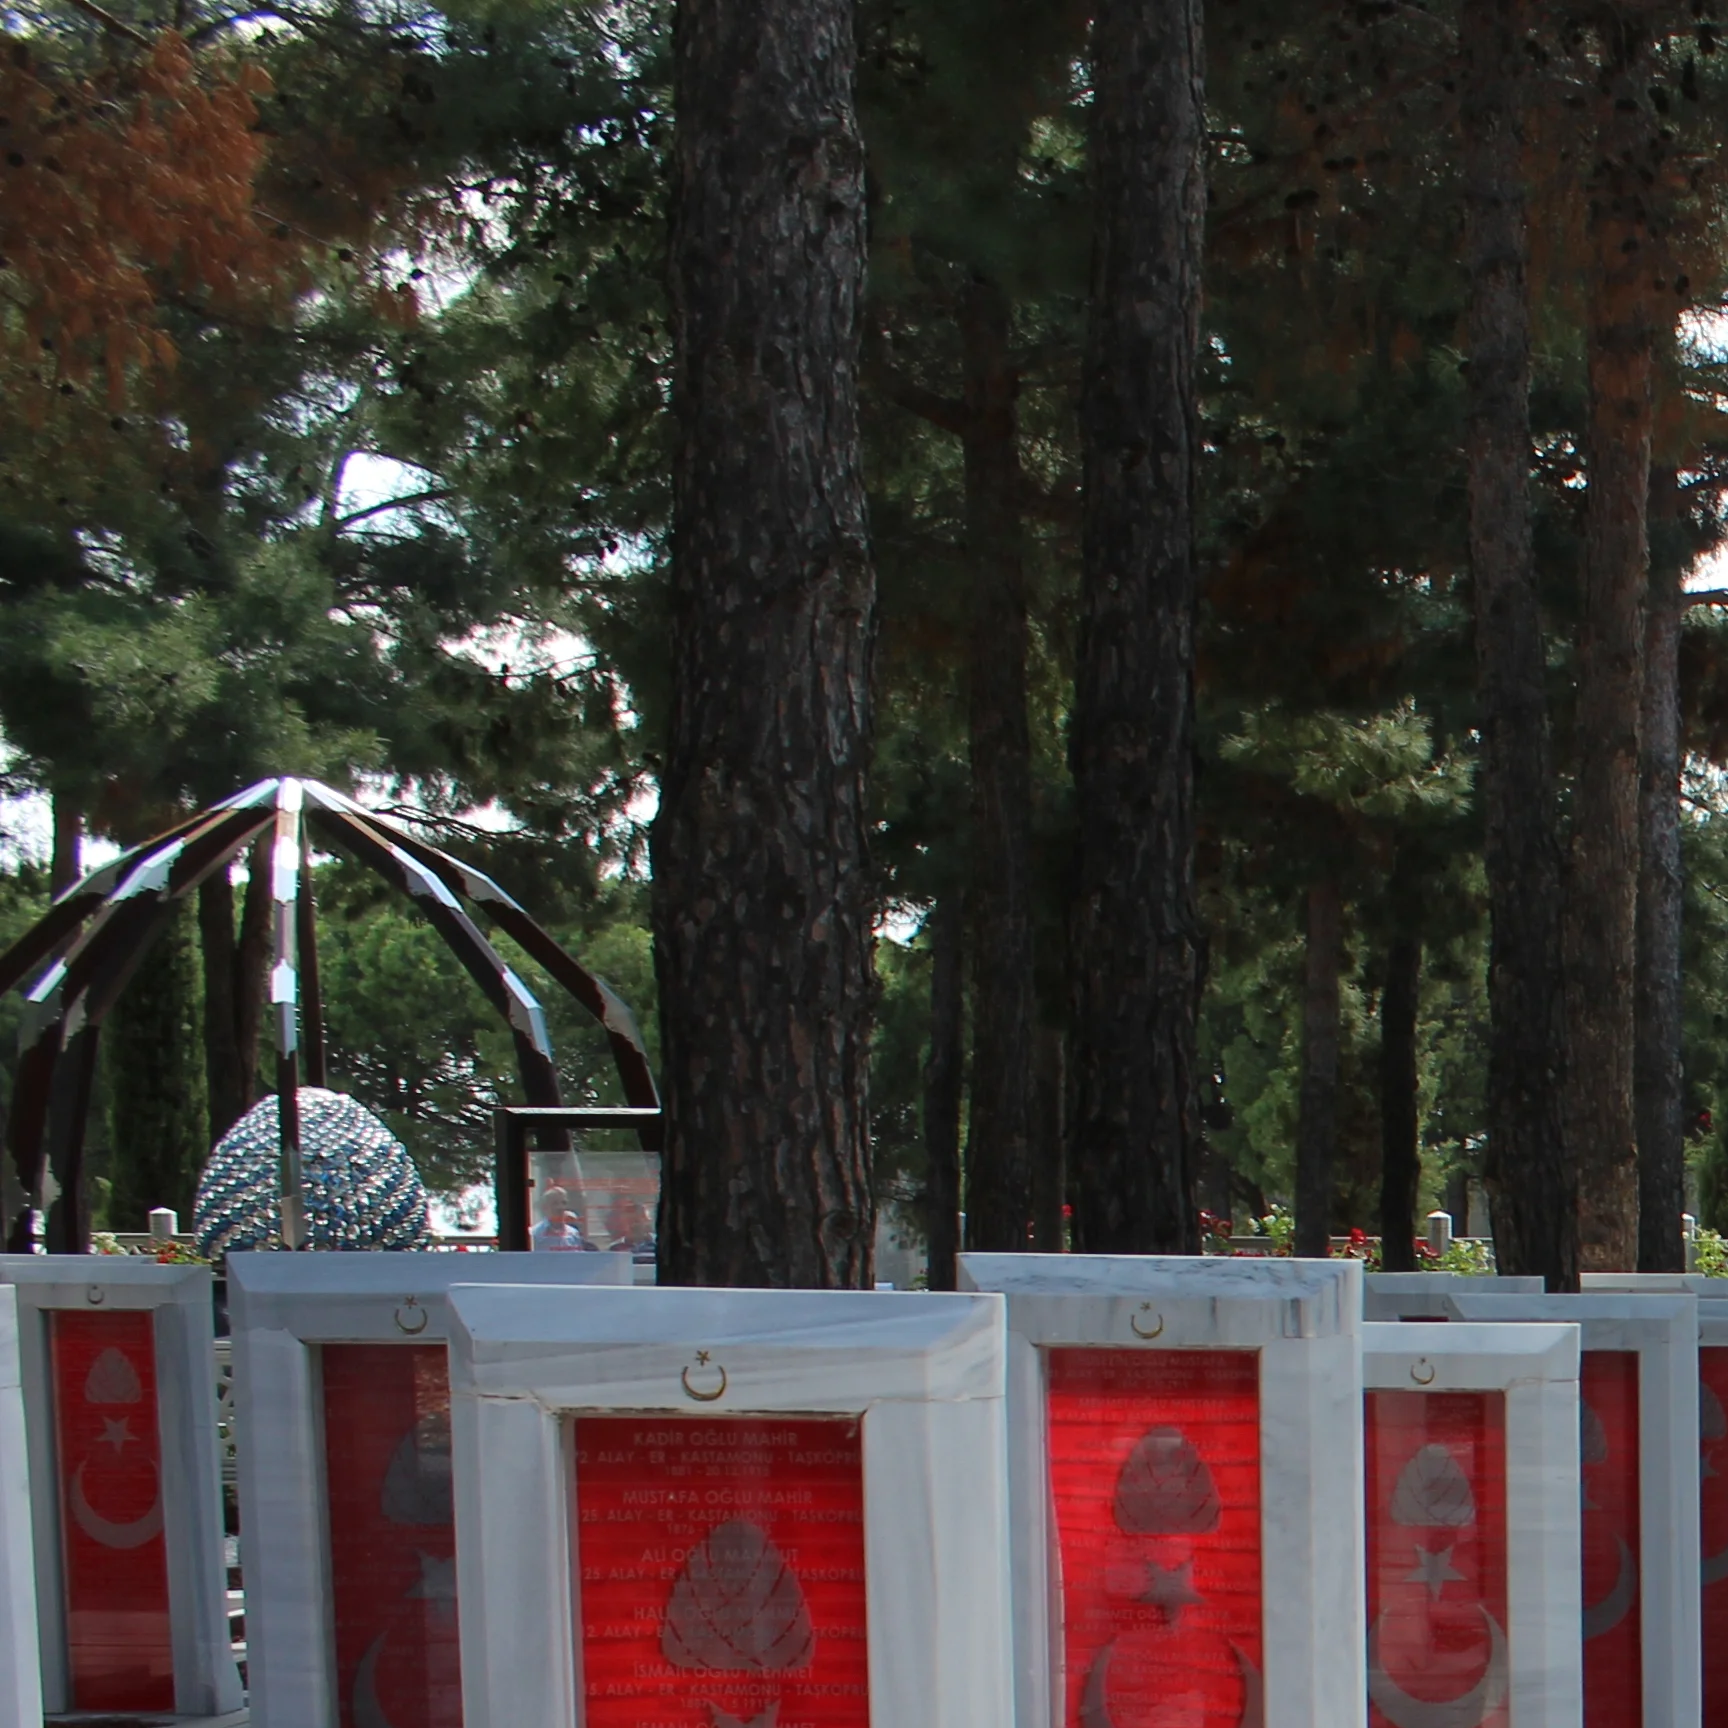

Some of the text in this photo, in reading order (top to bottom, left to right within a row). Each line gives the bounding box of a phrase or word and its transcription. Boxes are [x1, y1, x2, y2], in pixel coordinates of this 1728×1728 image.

[634, 1429, 798, 1446] KADİR OĞLU MAHİR
[598, 1452, 634, 1464] ALAY
[650, 1452, 665, 1464] ER
[681, 1452, 773, 1464] KASTAMONU
[623, 1487, 812, 1504] MUSTAFA OĞLU MAHİR
[608, 1510, 642, 1521] ALAY
[658, 1510, 673, 1521] ER
[688, 1510, 777, 1522] KASTAMONU
[642, 1547, 666, 1562] ALİ
[672, 1547, 718, 1562] OĞLU
[609, 1568, 645, 1580] ALAY
[604, 1626, 641, 1638] ALAY
[607, 1684, 642, 1696] ALAY
[659, 1684, 674, 1696] ER
[690, 1684, 780, 1696] KASTAMONU
